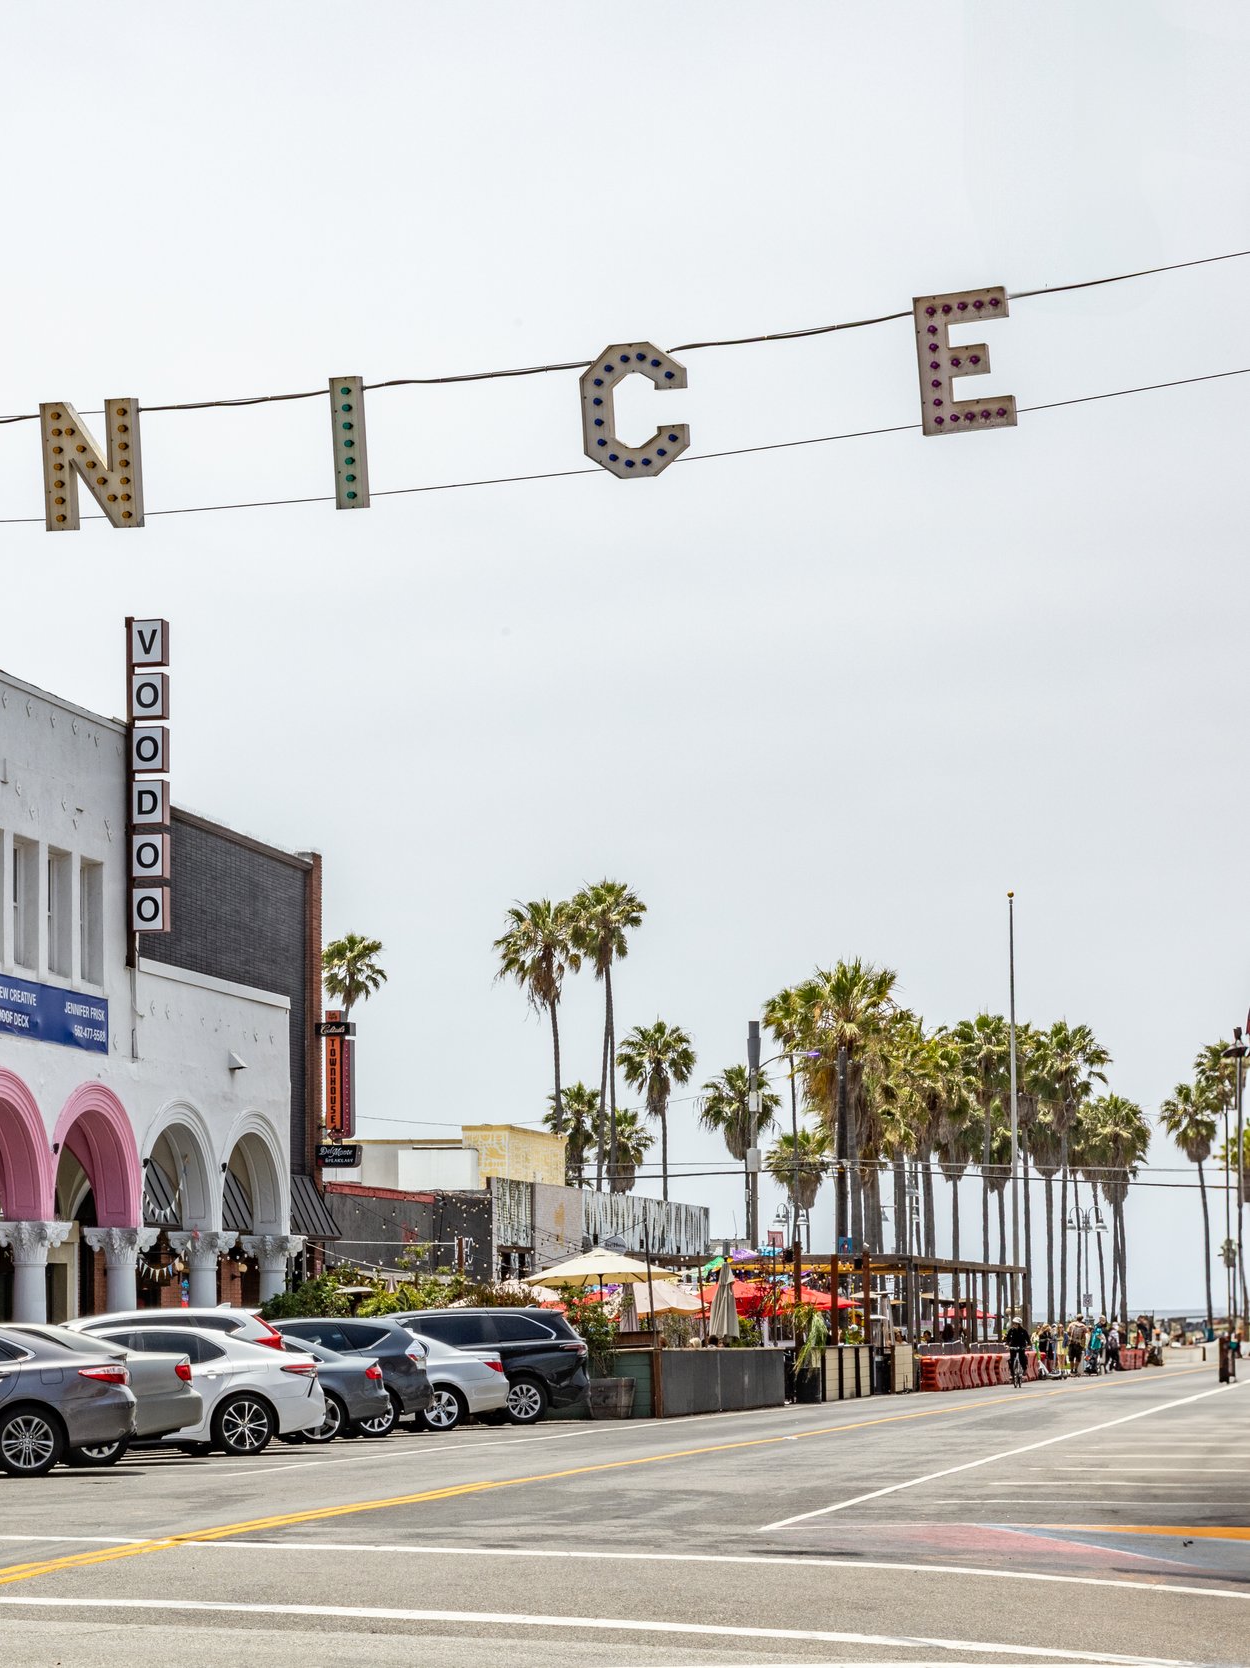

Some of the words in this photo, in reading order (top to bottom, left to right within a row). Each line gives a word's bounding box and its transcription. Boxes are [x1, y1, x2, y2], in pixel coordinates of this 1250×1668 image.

[135, 629, 160, 923] VOODOO
[9, 988, 37, 1006] CREATIVE
[13, 1012, 30, 1029] DECK
[64, 1001, 91, 1018] JENNIFER
[91, 1007, 106, 1022] FRISK
[329, 1038, 337, 1125] TOWNHOUSE
